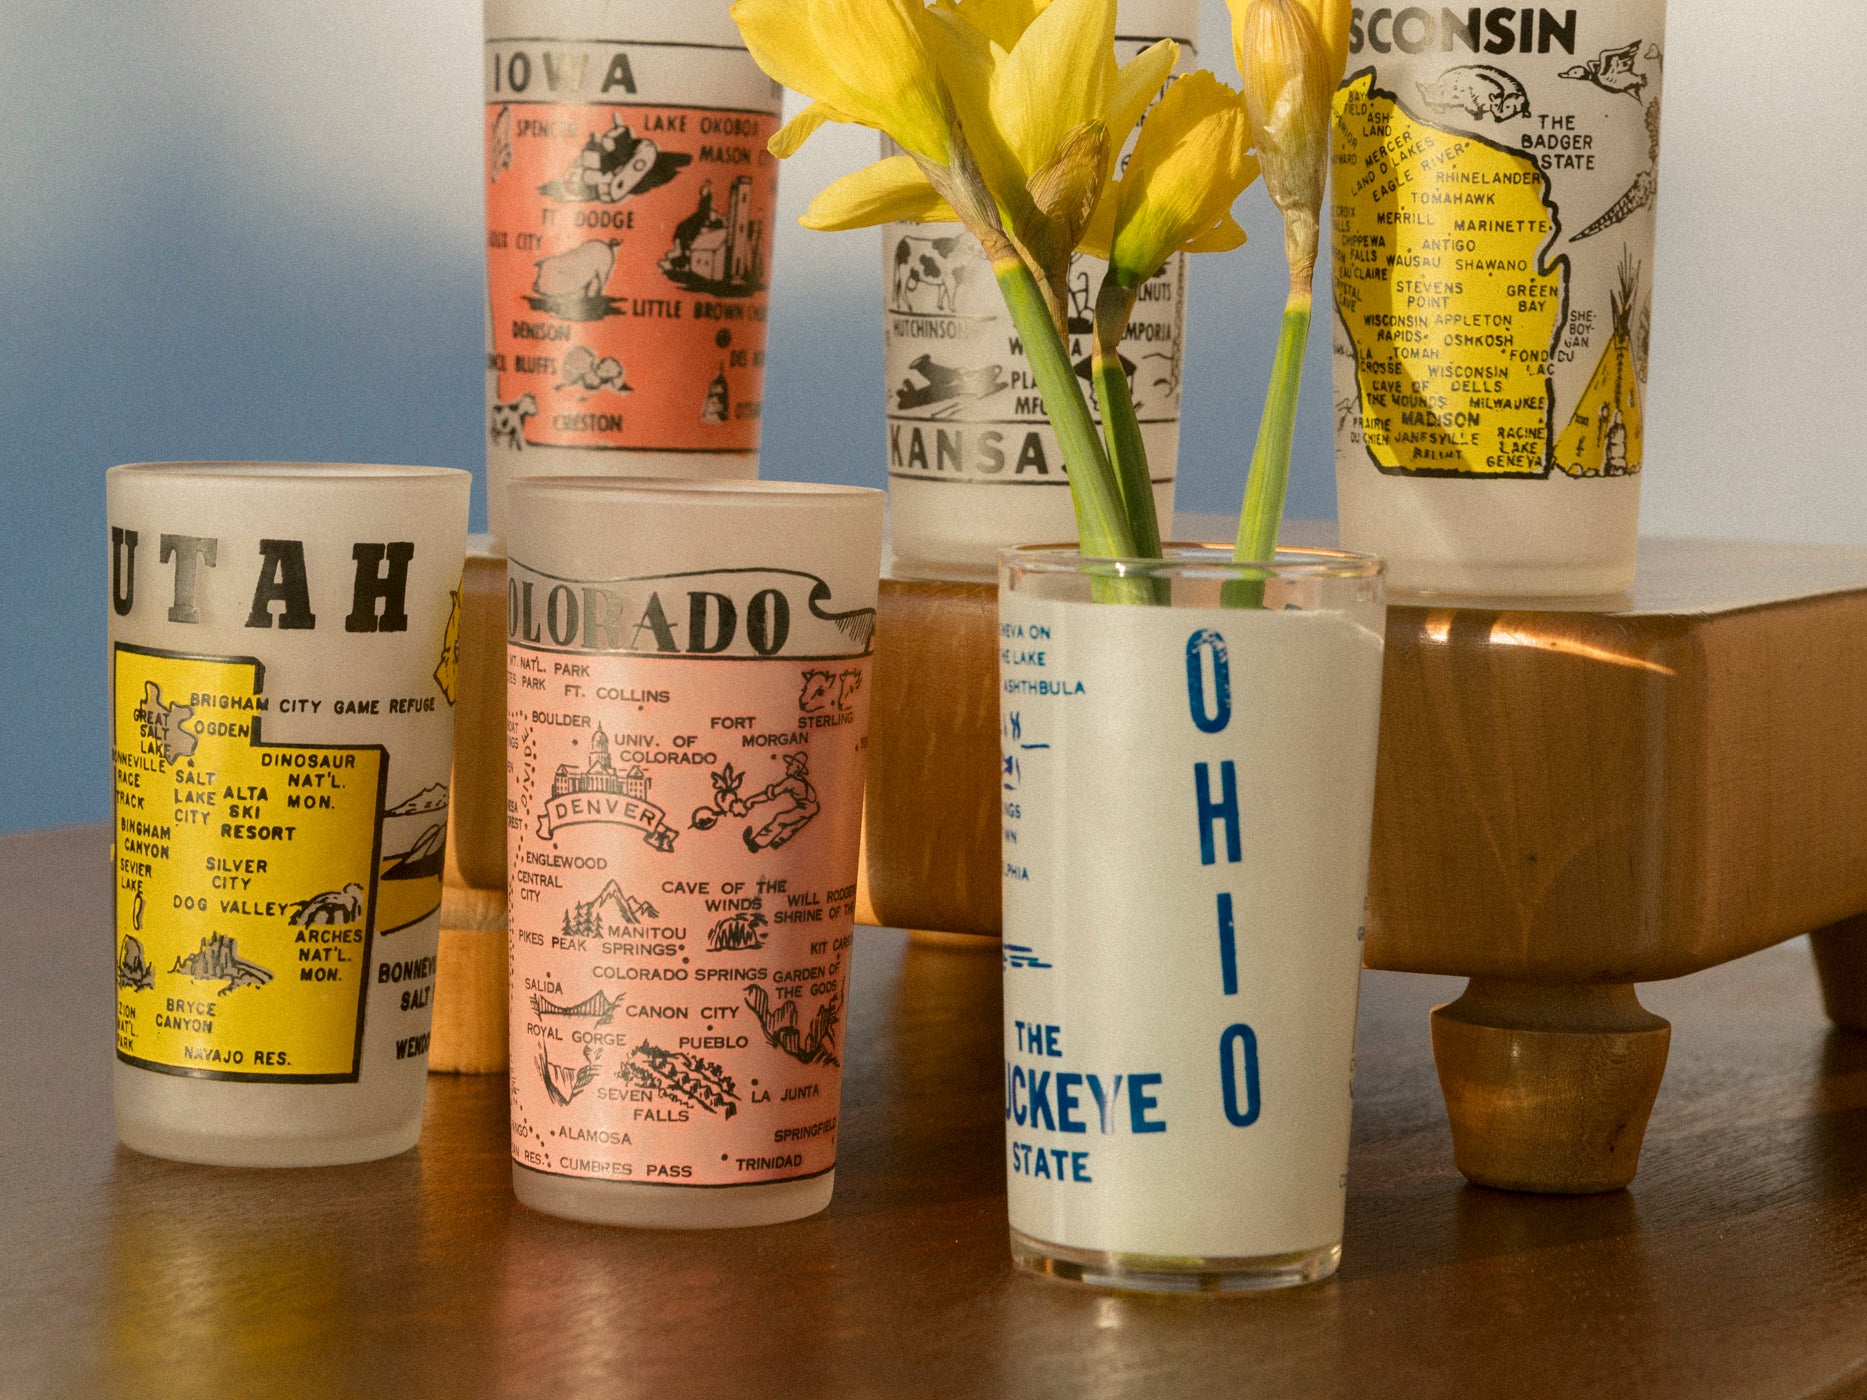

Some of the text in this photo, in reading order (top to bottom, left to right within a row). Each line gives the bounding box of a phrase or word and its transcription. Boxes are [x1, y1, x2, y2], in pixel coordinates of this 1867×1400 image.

[494, 52, 637, 93] IOWA
[645, 114, 686, 132] LAKE
[1538, 115, 1575, 130] THE
[1363, 126, 1392, 137] LAND
[1365, 131, 1412, 168] MERCER
[1521, 134, 1593, 150] BADGER
[699, 146, 750, 164] MASON
[1541, 154, 1595, 170] STATE
[1351, 137, 1435, 196] LAND O LAKES
[1372, 144, 1465, 202] EAGLE RIVER
[1436, 172, 1540, 184] RHINELANDER
[1411, 192, 1495, 205] TOMAHAWK
[575, 210, 634, 229] DODGE
[1377, 212, 1435, 225] MERRILL
[1454, 220, 1547, 232] MARINETTE
[516, 233, 542, 250] CITY
[1342, 235, 1386, 247] CHIPPEWA
[1422, 239, 1476, 251] ANTIGO
[1351, 250, 1377, 262] FALLS
[1386, 255, 1441, 267] WAUSAU
[1455, 259, 1527, 271] SHAWANO
[1354, 268, 1388, 281] CLAIRE
[1396, 281, 1463, 294] STEVENS
[1507, 285, 1558, 297] GREEN
[632, 299, 682, 319] LITTLE
[693, 302, 744, 320] BROWN
[1407, 296, 1449, 308] POINT
[1518, 301, 1546, 312] BAY
[1364, 314, 1428, 327] WISCONSIN
[1435, 314, 1511, 327] APPLETON
[513, 321, 570, 341] DENISON
[1444, 334, 1513, 347] OSHKOSH
[1394, 347, 1439, 359] TOMAH
[1509, 350, 1549, 362] FOND
[516, 355, 556, 374] BLUFFS
[1360, 361, 1402, 375] CROSSE
[1428, 364, 1508, 379] WISCONSIN
[1372, 380, 1430, 393] CAVE OF
[1451, 380, 1502, 393] DELLS
[1367, 393, 1448, 409] THE MOUNDS
[1469, 397, 1545, 410] MILWAUKEE
[554, 413, 623, 432] CRESTON
[1353, 417, 1391, 431] PRAIRIE
[1402, 411, 1480, 427] MADISON
[1395, 432, 1480, 446] JANESVILLE
[1497, 427, 1545, 439] RACINE
[890, 425, 1068, 474] KANSA
[1499, 441, 1537, 454] LAKE
[1486, 456, 1543, 468] GENEVA
[111, 526, 414, 633] UTAH
[1029, 624, 1051, 640] ON
[1013, 650, 1046, 666] LAKE
[554, 663, 591, 677] PARK
[521, 676, 546, 690] PARK
[1004, 680, 1086, 695] ASHTHBULA
[564, 684, 671, 703] FT. COLLINS
[190, 692, 435, 714] BRIGHAM CITY GAME REFUGE
[134, 709, 170, 726] GREAT
[532, 710, 591, 728] BOULDER
[711, 717, 756, 729] FORT
[798, 712, 853, 729] STERLING
[140, 725, 169, 740] SALT
[194, 720, 249, 738] OGDEN
[615, 734, 698, 748] UNIV. OF
[742, 732, 809, 747] MORGAN
[141, 741, 171, 758] LAKE
[620, 750, 717, 765] COLORADO
[261, 753, 355, 769] DINOSAUR
[118, 769, 140, 788] RACE
[176, 770, 216, 786] SALT
[288, 772, 346, 788] NAT'L.
[117, 790, 145, 810] TRACK
[174, 788, 217, 806] LAKE
[223, 786, 268, 801] ALTA
[287, 796, 334, 809] MON.
[175, 809, 210, 825] CITY
[229, 804, 260, 819] SKI
[555, 798, 656, 827] DENVER
[121, 817, 171, 840] BINGHAM
[221, 824, 296, 841] RESORT
[124, 837, 170, 859] CANYON
[120, 858, 152, 878] SEVIER
[206, 856, 267, 873] SILVER
[526, 852, 608, 870] ENGLEWOOD
[121, 877, 143, 894] LAKE
[212, 876, 252, 890] CITY
[517, 870, 563, 888] CENTRAL
[1186, 628, 1261, 1128] OHIO
[520, 888, 541, 902] CITY
[661, 880, 787, 895] CAVE OF THE
[173, 894, 288, 916] DOG VALLEY
[705, 898, 763, 912] WINDS
[787, 892, 820, 907] WILL
[773, 906, 841, 924] SHRINE OF
[295, 929, 363, 943] ARCHES
[518, 929, 587, 951] PIKES PEAK
[608, 925, 687, 940] MANITOU
[299, 947, 351, 962] NAT'L.
[602, 942, 677, 956] SPRINGS
[810, 941, 828, 955] KIT
[300, 968, 342, 982] MON.
[592, 966, 768, 982] COLORADO SPRINGS
[772, 962, 841, 983] GARDEN OF
[525, 978, 563, 995] SALIDA
[775, 979, 837, 999] THE GODS
[400, 986, 430, 1011] SALT
[118, 1002, 136, 1019] ZION
[166, 998, 217, 1016] BRYCE
[625, 1005, 740, 1019] CANON CITY
[155, 1014, 213, 1033] CANYON
[527, 1022, 627, 1046] ROYAL GORGE
[1014, 1020, 1063, 1057] THE
[679, 1036, 749, 1049] PUEBLO
[184, 1046, 291, 1065] NAVAJO RES.
[597, 1088, 653, 1103] SEVEN
[751, 1084, 819, 1103] LA JUNTA
[633, 1109, 690, 1122] FALLS
[558, 1125, 632, 1145] ALAMOSA
[774, 1116, 837, 1143] SPRINGFIELD
[524, 1149, 545, 1166] RES.
[735, 1154, 802, 1171] TRINIDAD
[1013, 1141, 1093, 1183] STATE
[560, 1156, 692, 1178] CUMBRES PASS
